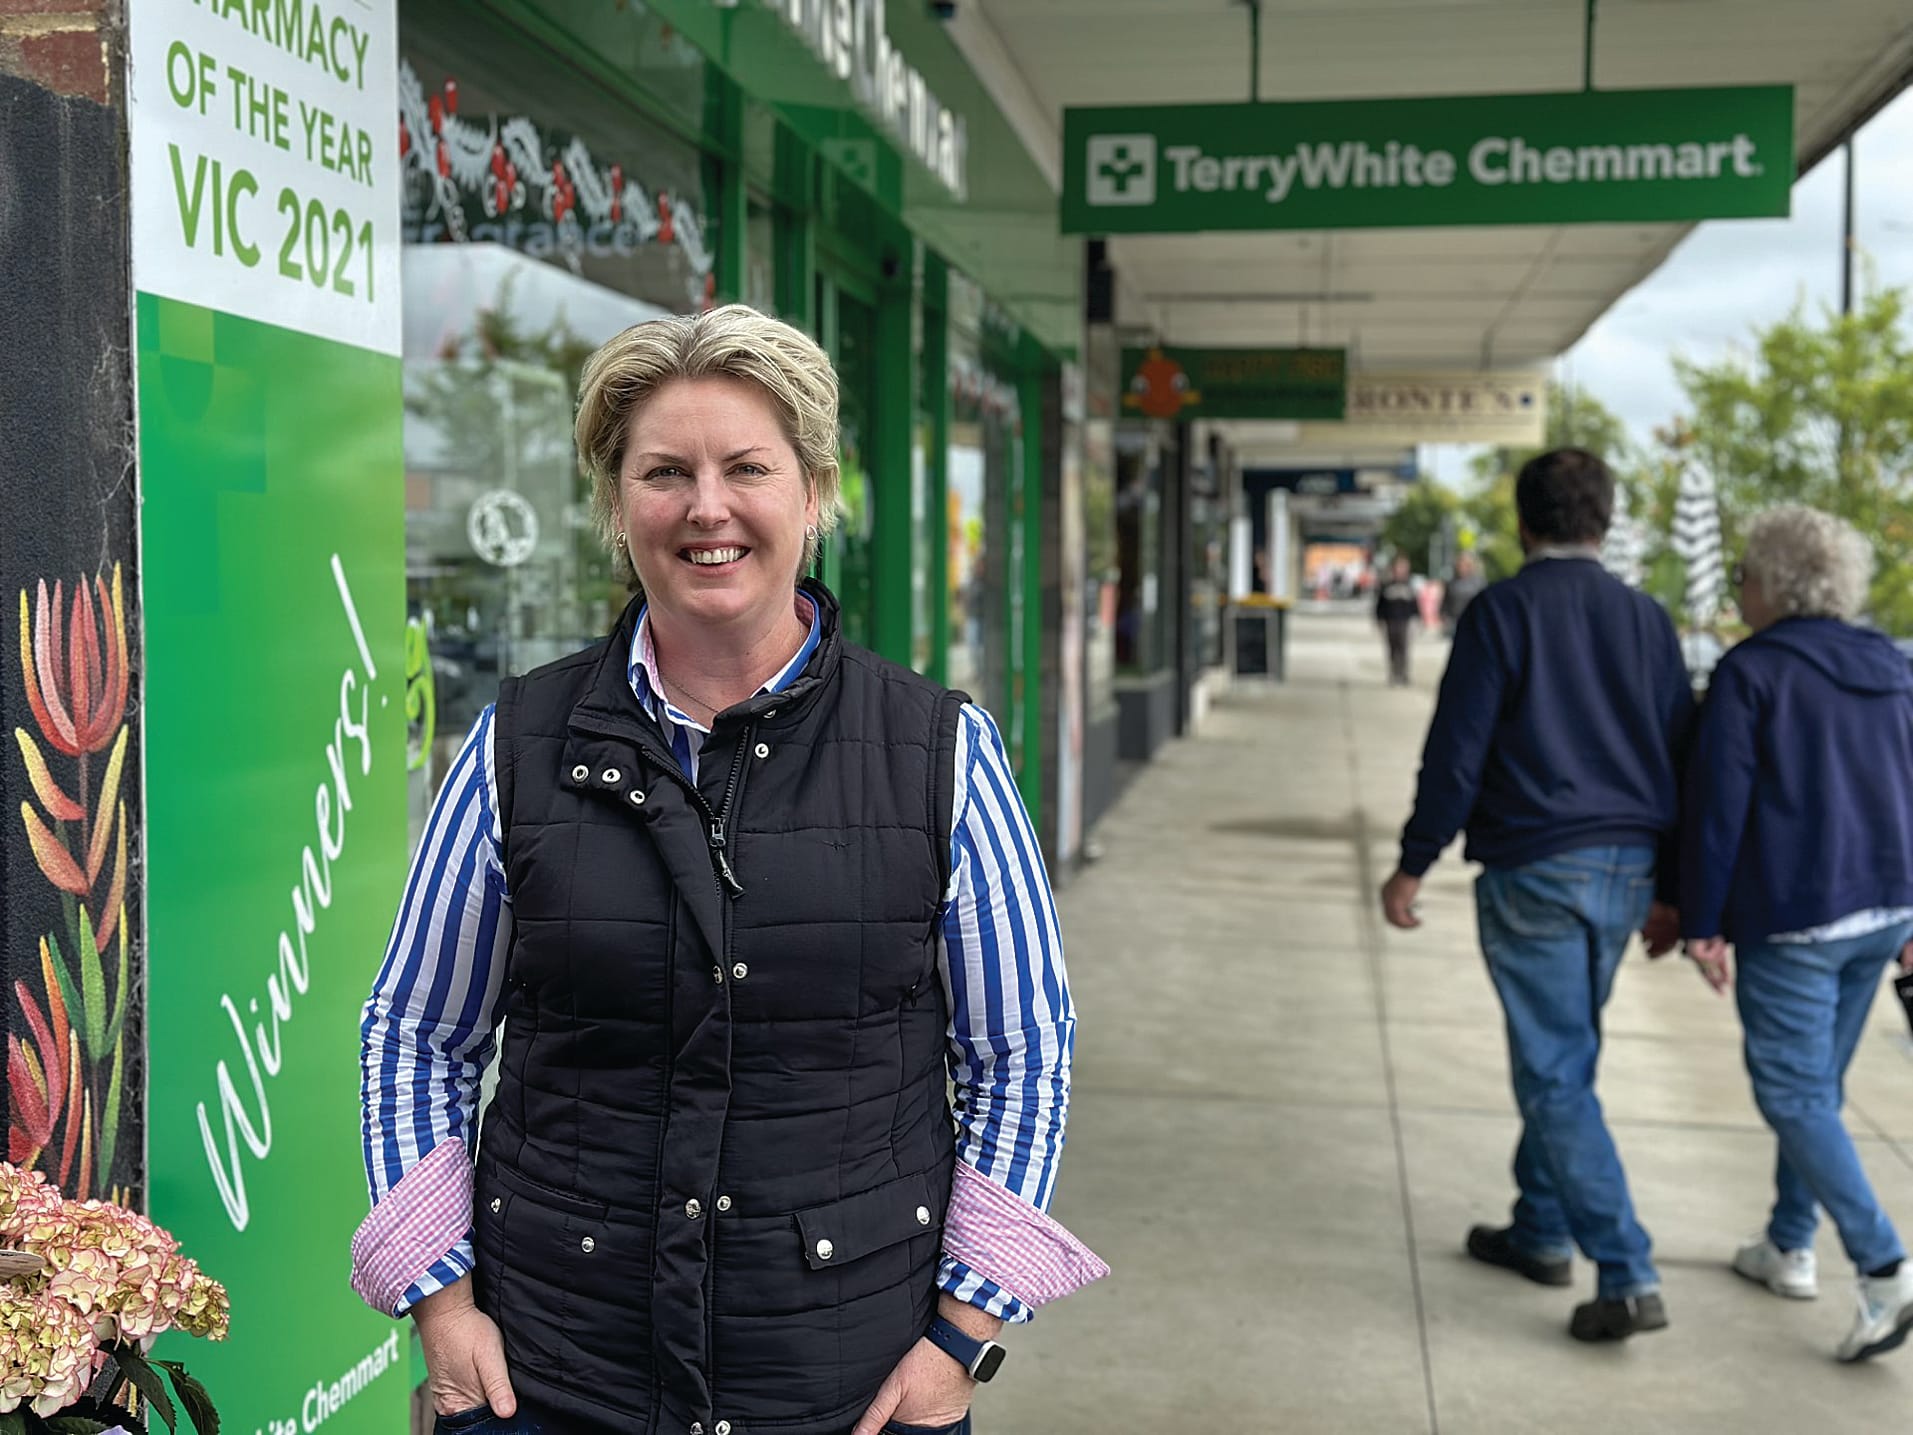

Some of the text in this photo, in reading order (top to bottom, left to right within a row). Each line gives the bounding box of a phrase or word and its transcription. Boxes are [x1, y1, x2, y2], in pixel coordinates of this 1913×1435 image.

[193, 0, 369, 91] RMACY
[166, 40, 373, 188] OF THE YEAR
[1164, 140, 1457, 203] TerryWhite
[167, 142, 374, 304] VIC 2021
[197, 553, 387, 1232] Winners!
[302, 1327, 399, 1434] Chemmart
